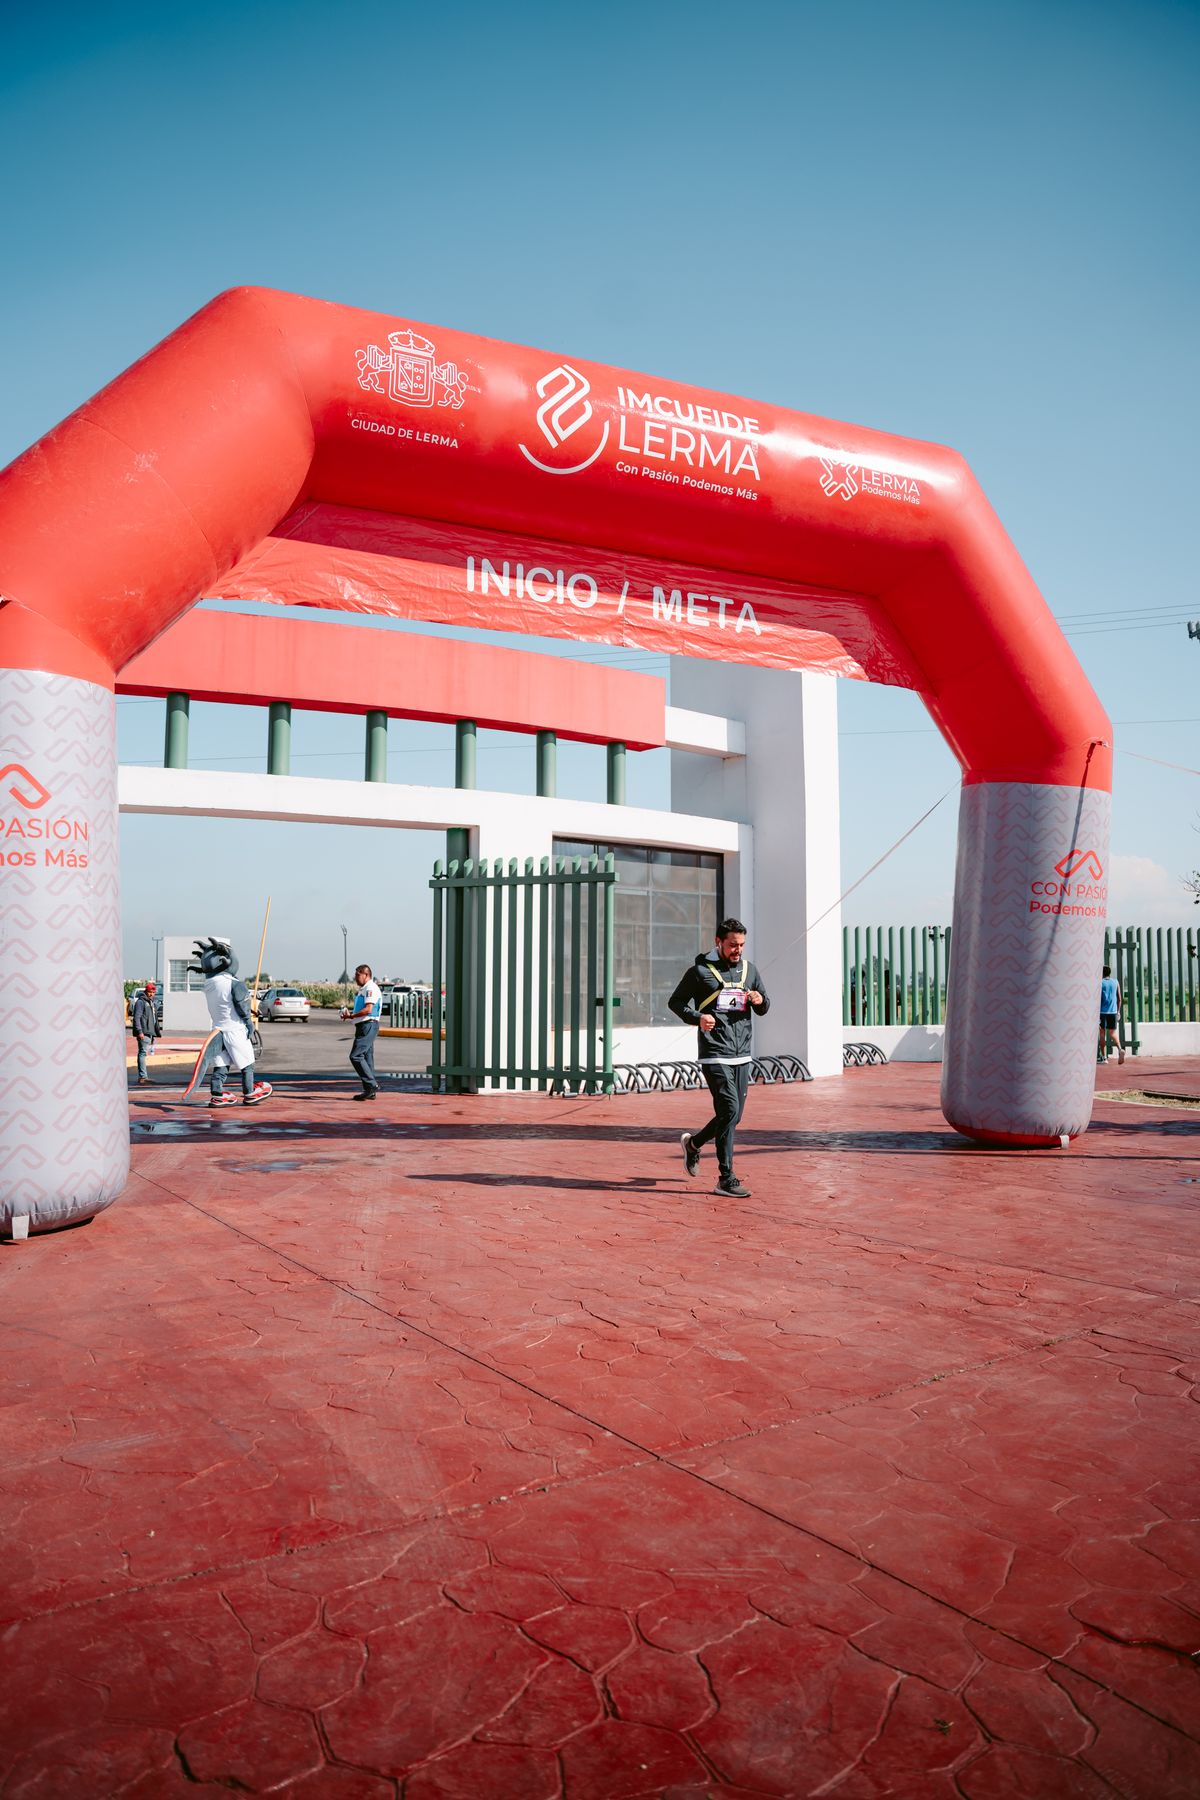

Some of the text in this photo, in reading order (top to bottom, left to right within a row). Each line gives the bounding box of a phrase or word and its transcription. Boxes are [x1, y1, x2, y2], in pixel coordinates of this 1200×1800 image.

[351, 419, 459, 449] CIUDAD DE LERMA
[618, 415, 761, 481] LERMA
[615, 461, 758, 501] Con Pasión Podemos Más
[861, 468, 920, 496] LERMA
[861, 483, 920, 505] Podemos Más
[466, 556, 762, 636] INICIO / META
[45, 848, 88, 868] Más
[1031, 881, 1071, 897] CON
[1029, 900, 1096, 917] Podemos
[729, 997, 737, 1008] 4
